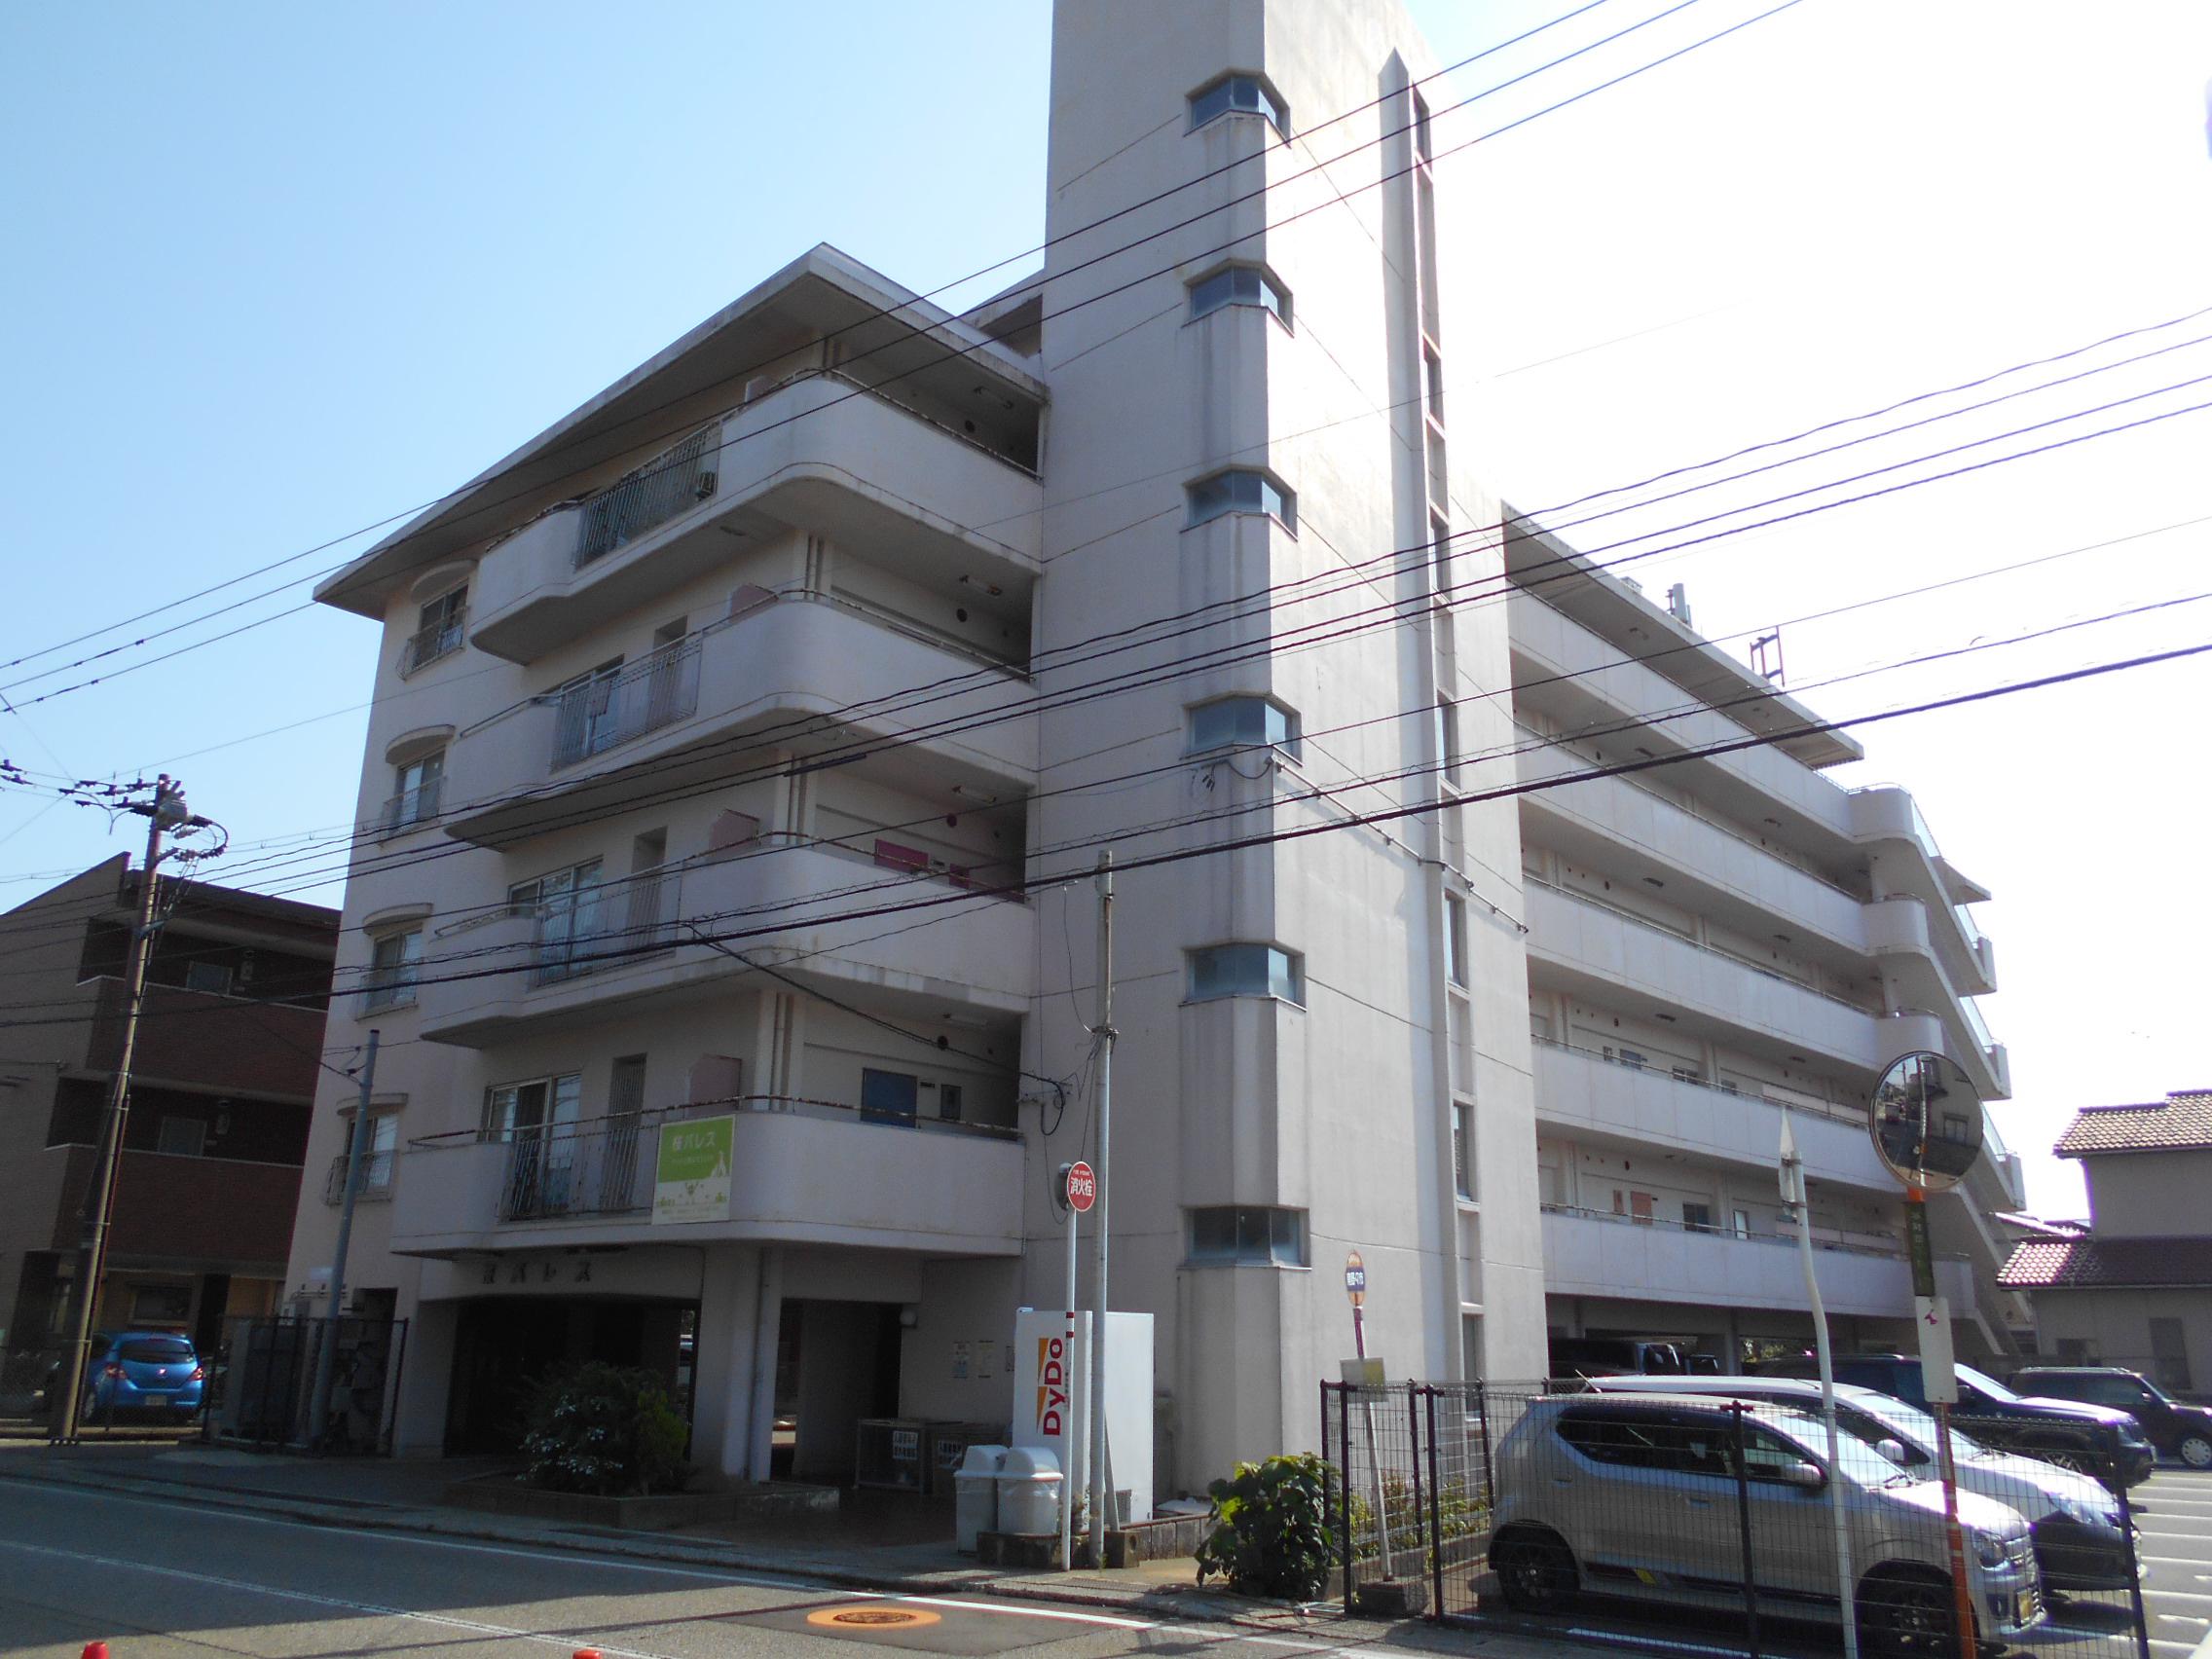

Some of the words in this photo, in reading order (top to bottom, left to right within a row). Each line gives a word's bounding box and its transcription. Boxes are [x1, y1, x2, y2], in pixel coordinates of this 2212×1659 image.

[1070, 1176, 1092, 1197] 消火栓
[1044, 1339, 1065, 1435] DyDo
